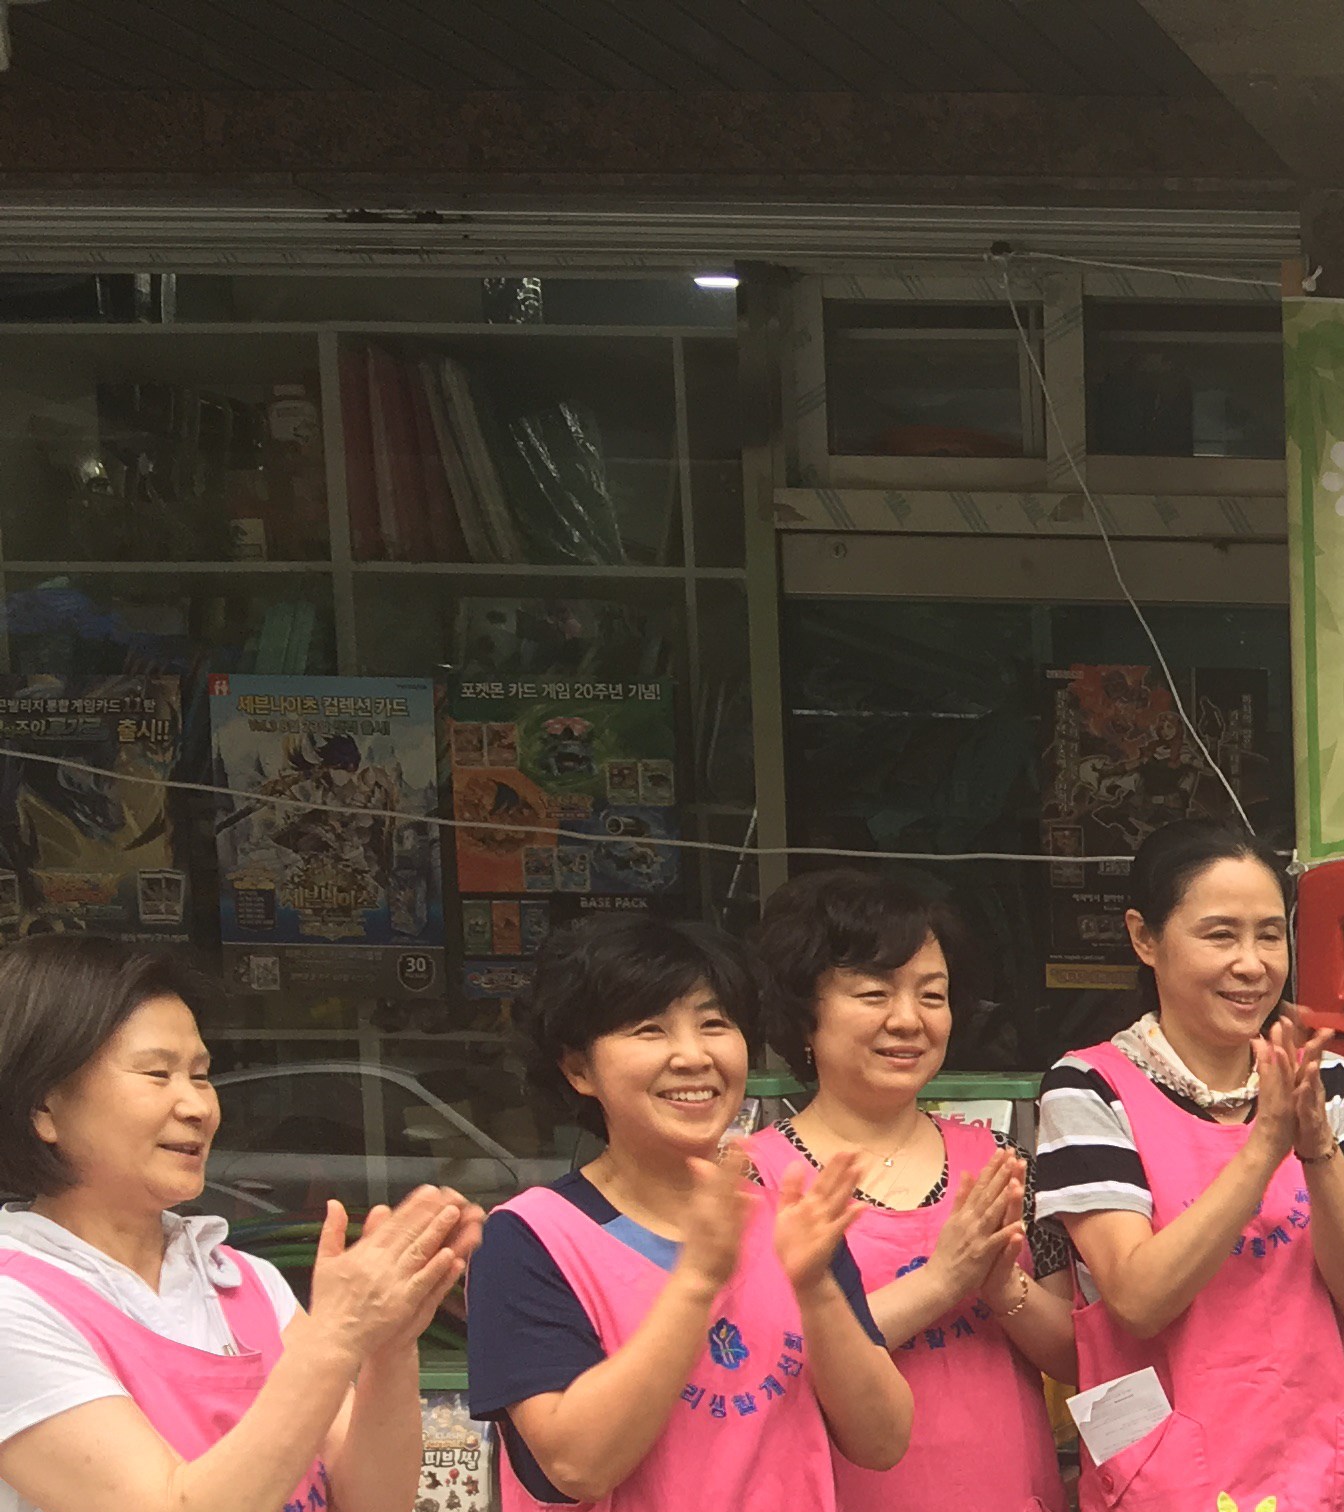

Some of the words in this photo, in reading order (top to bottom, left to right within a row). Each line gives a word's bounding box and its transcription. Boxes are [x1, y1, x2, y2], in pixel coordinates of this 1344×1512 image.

[460, 682, 505, 699] 포켓몬
[508, 682, 538, 699] 카드
[543, 683, 570, 700] 게임
[574, 684, 623, 700] 20주년
[628, 684, 661, 700] 기념!
[117, 718, 170, 742] 출시!!
[580, 897, 611, 908] BASE
[614, 897, 648, 909] PACK
[405, 957, 427, 973] 30
